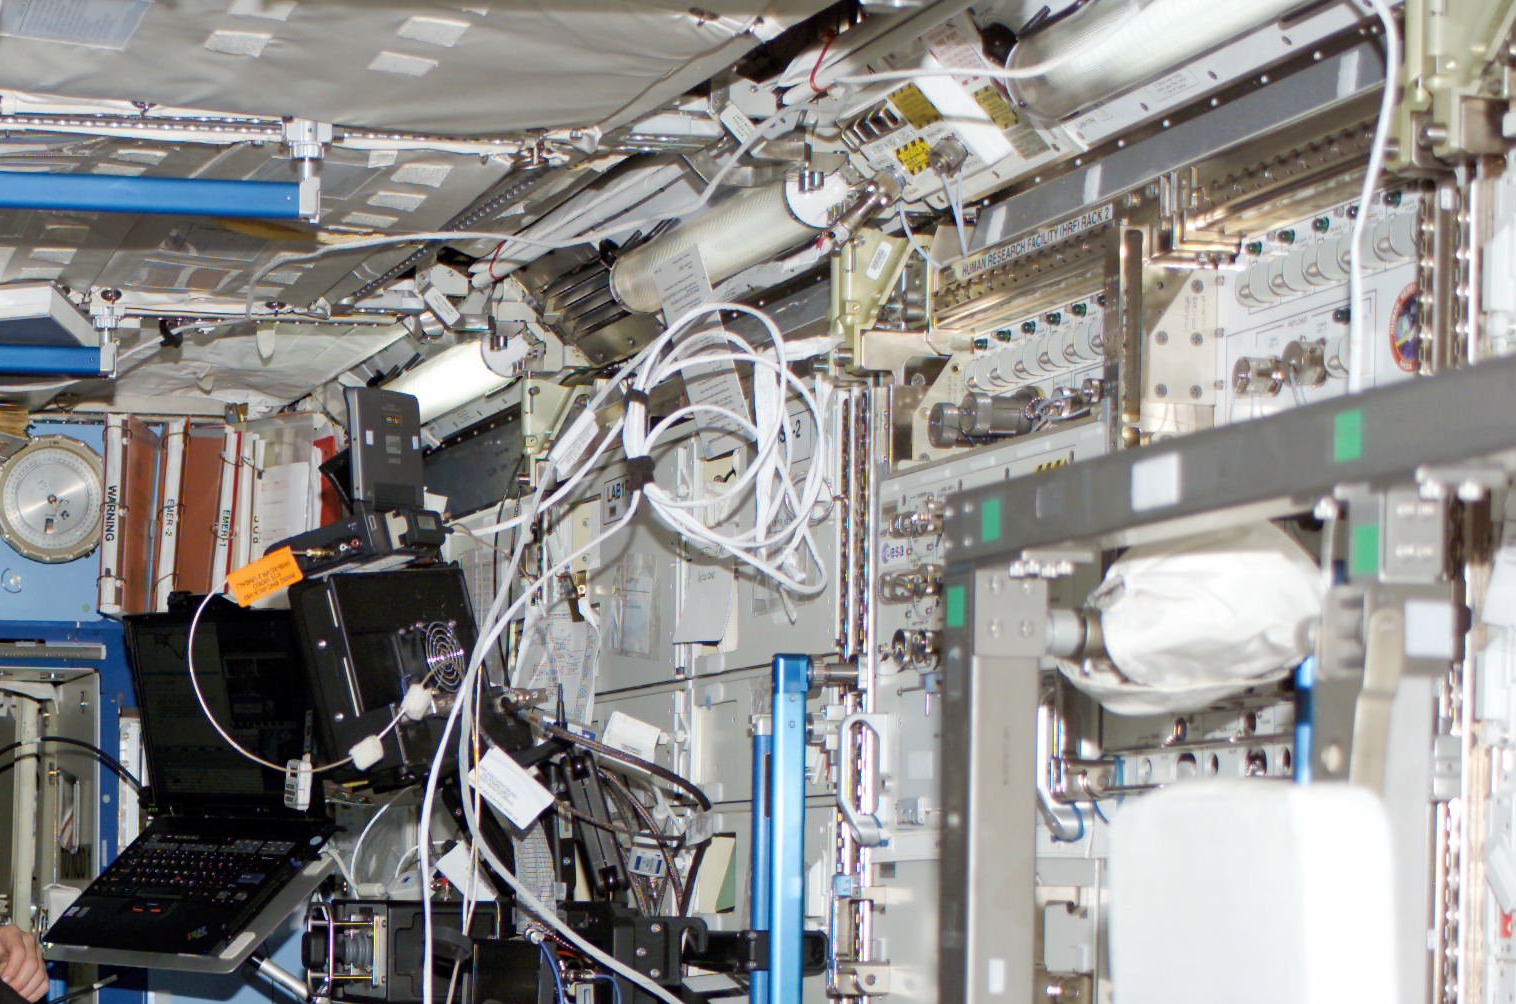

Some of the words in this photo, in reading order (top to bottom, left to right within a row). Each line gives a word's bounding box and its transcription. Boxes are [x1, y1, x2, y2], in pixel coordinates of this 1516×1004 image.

[962, 254, 986, 278] HUMAN
[988, 240, 1026, 268] RESEARCH
[1027, 228, 1058, 252] FACILITY
[1059, 218, 1080, 238] (HRF)
[1082, 209, 1103, 230] RACK
[1104, 206, 1110, 221] 2
[105, 485, 118, 541] WARNING
